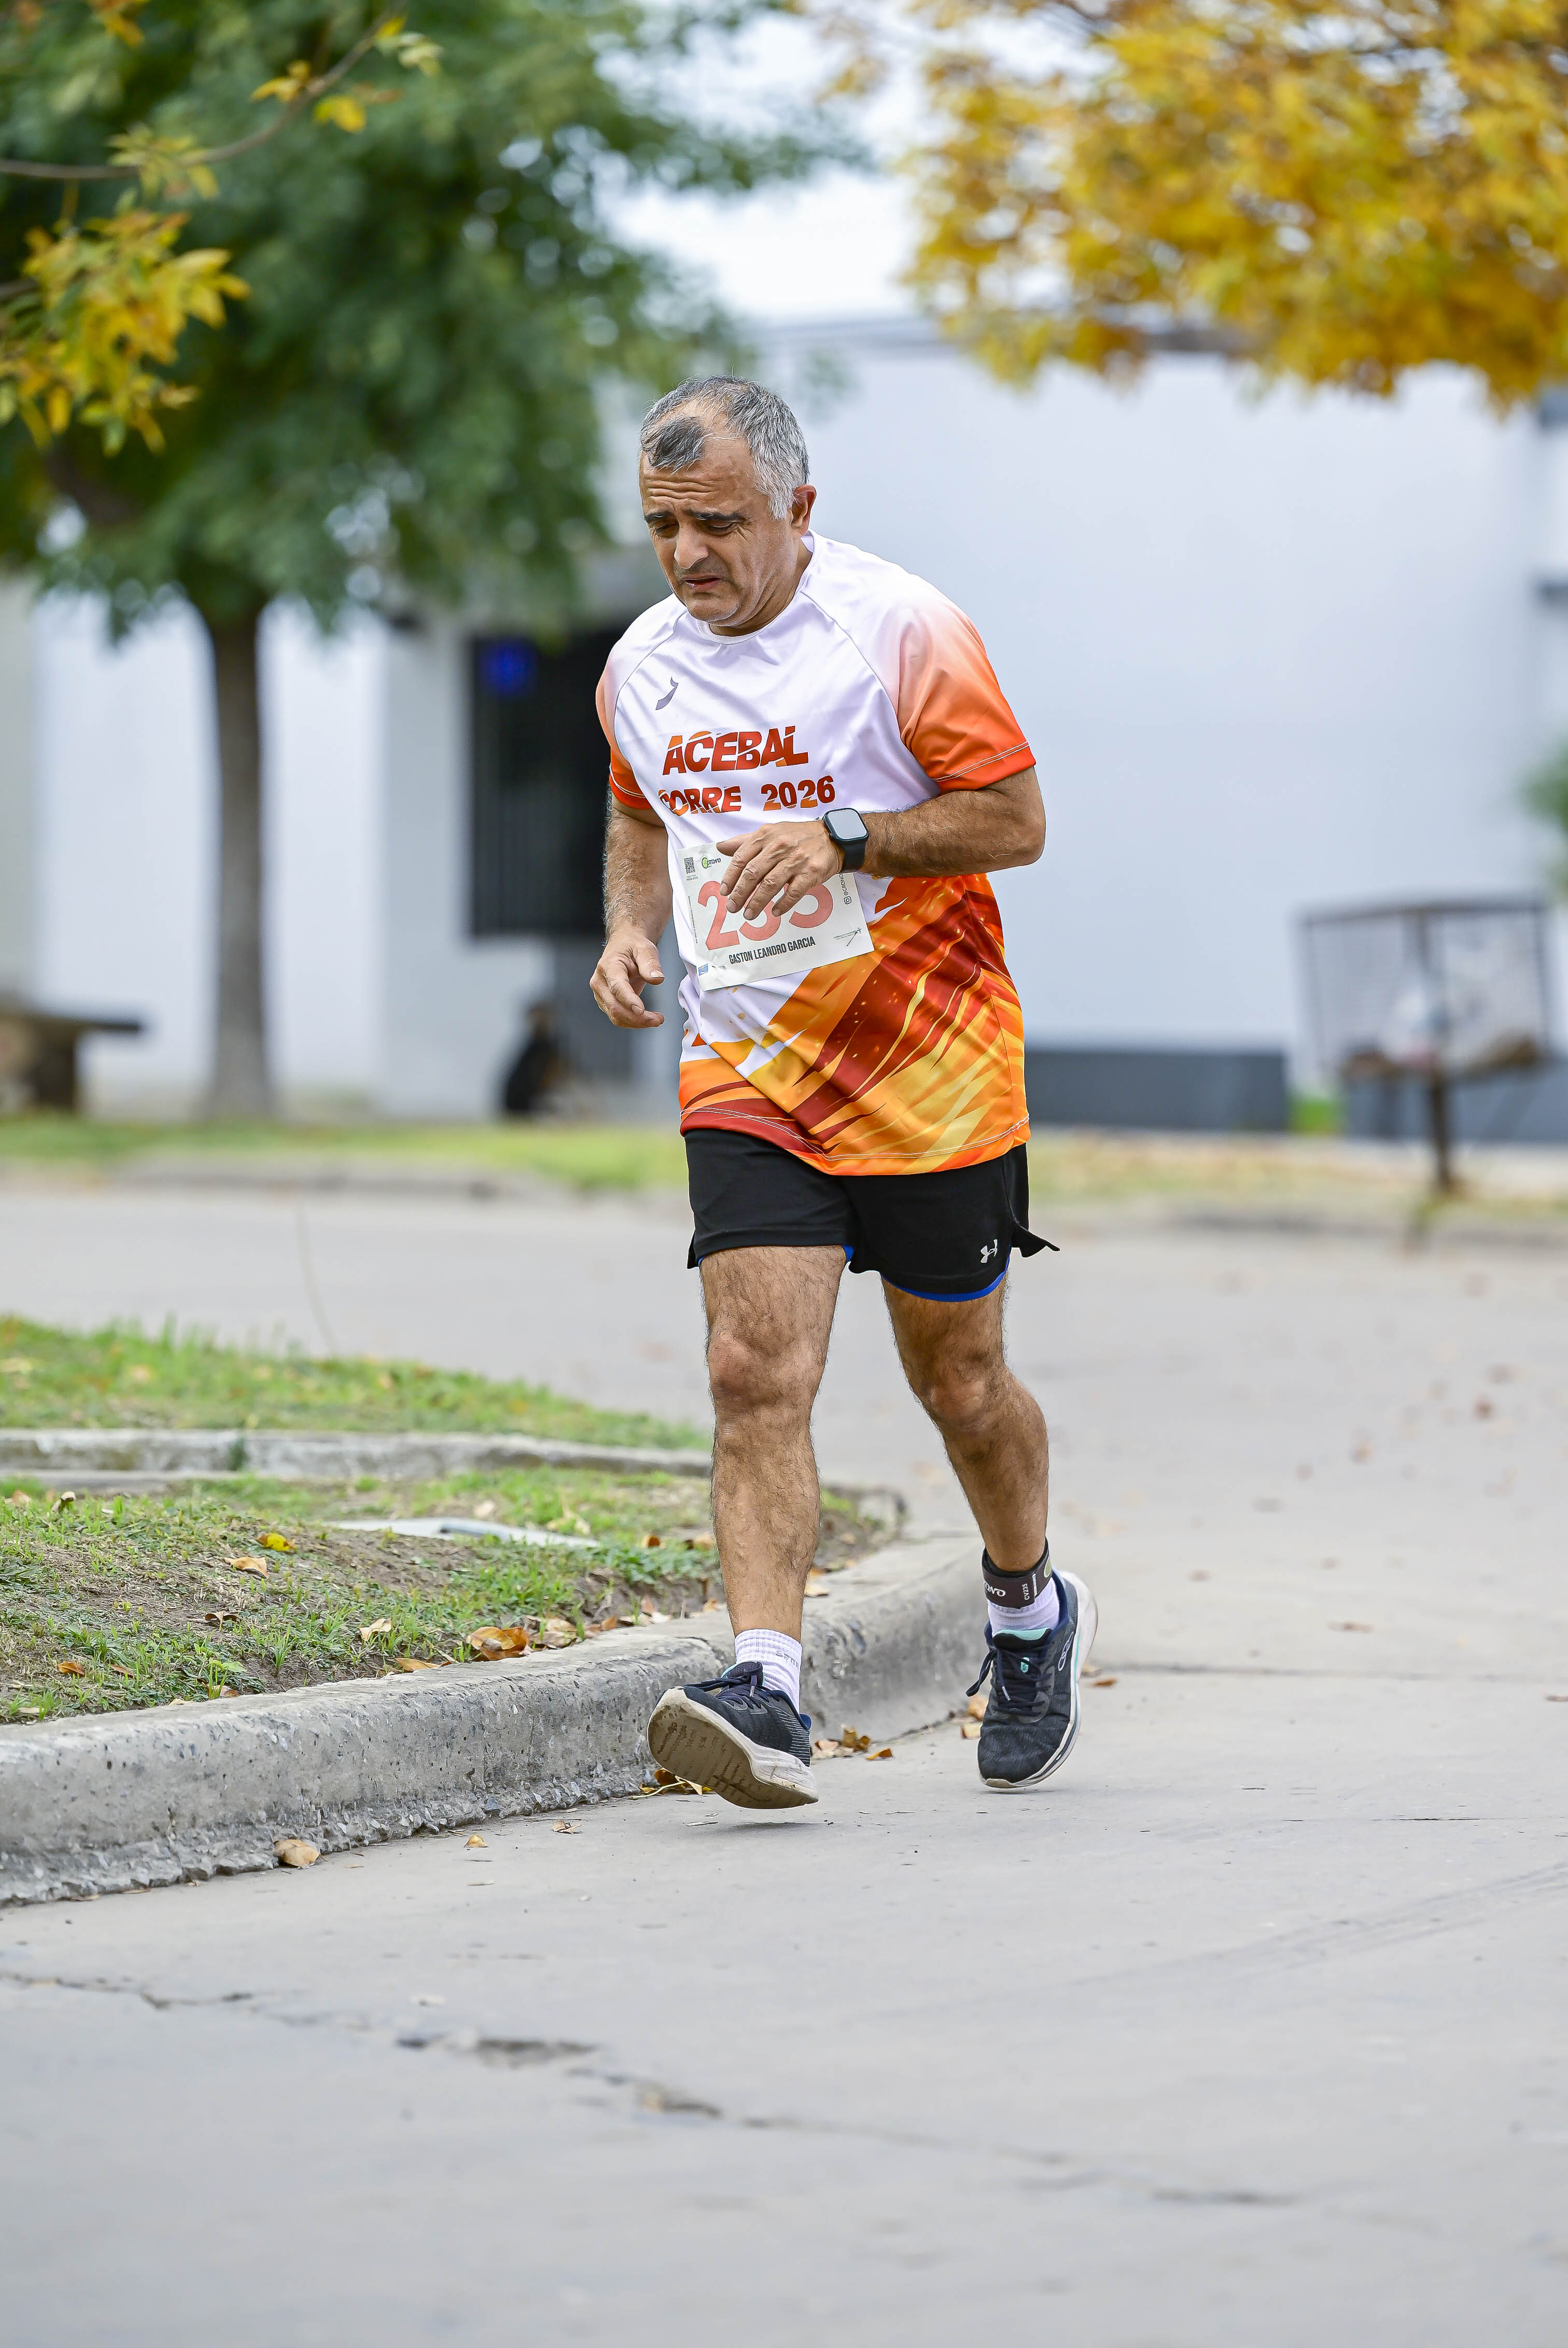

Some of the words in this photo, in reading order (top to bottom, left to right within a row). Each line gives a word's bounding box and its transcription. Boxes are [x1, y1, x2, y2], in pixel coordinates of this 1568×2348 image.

[663, 725, 809, 775] ACEBAL
[761, 775, 835, 812] 2026
[729, 951, 753, 965] GASTON
[753, 943, 787, 959] LEANDRO
[788, 936, 816, 951] GARCIA
